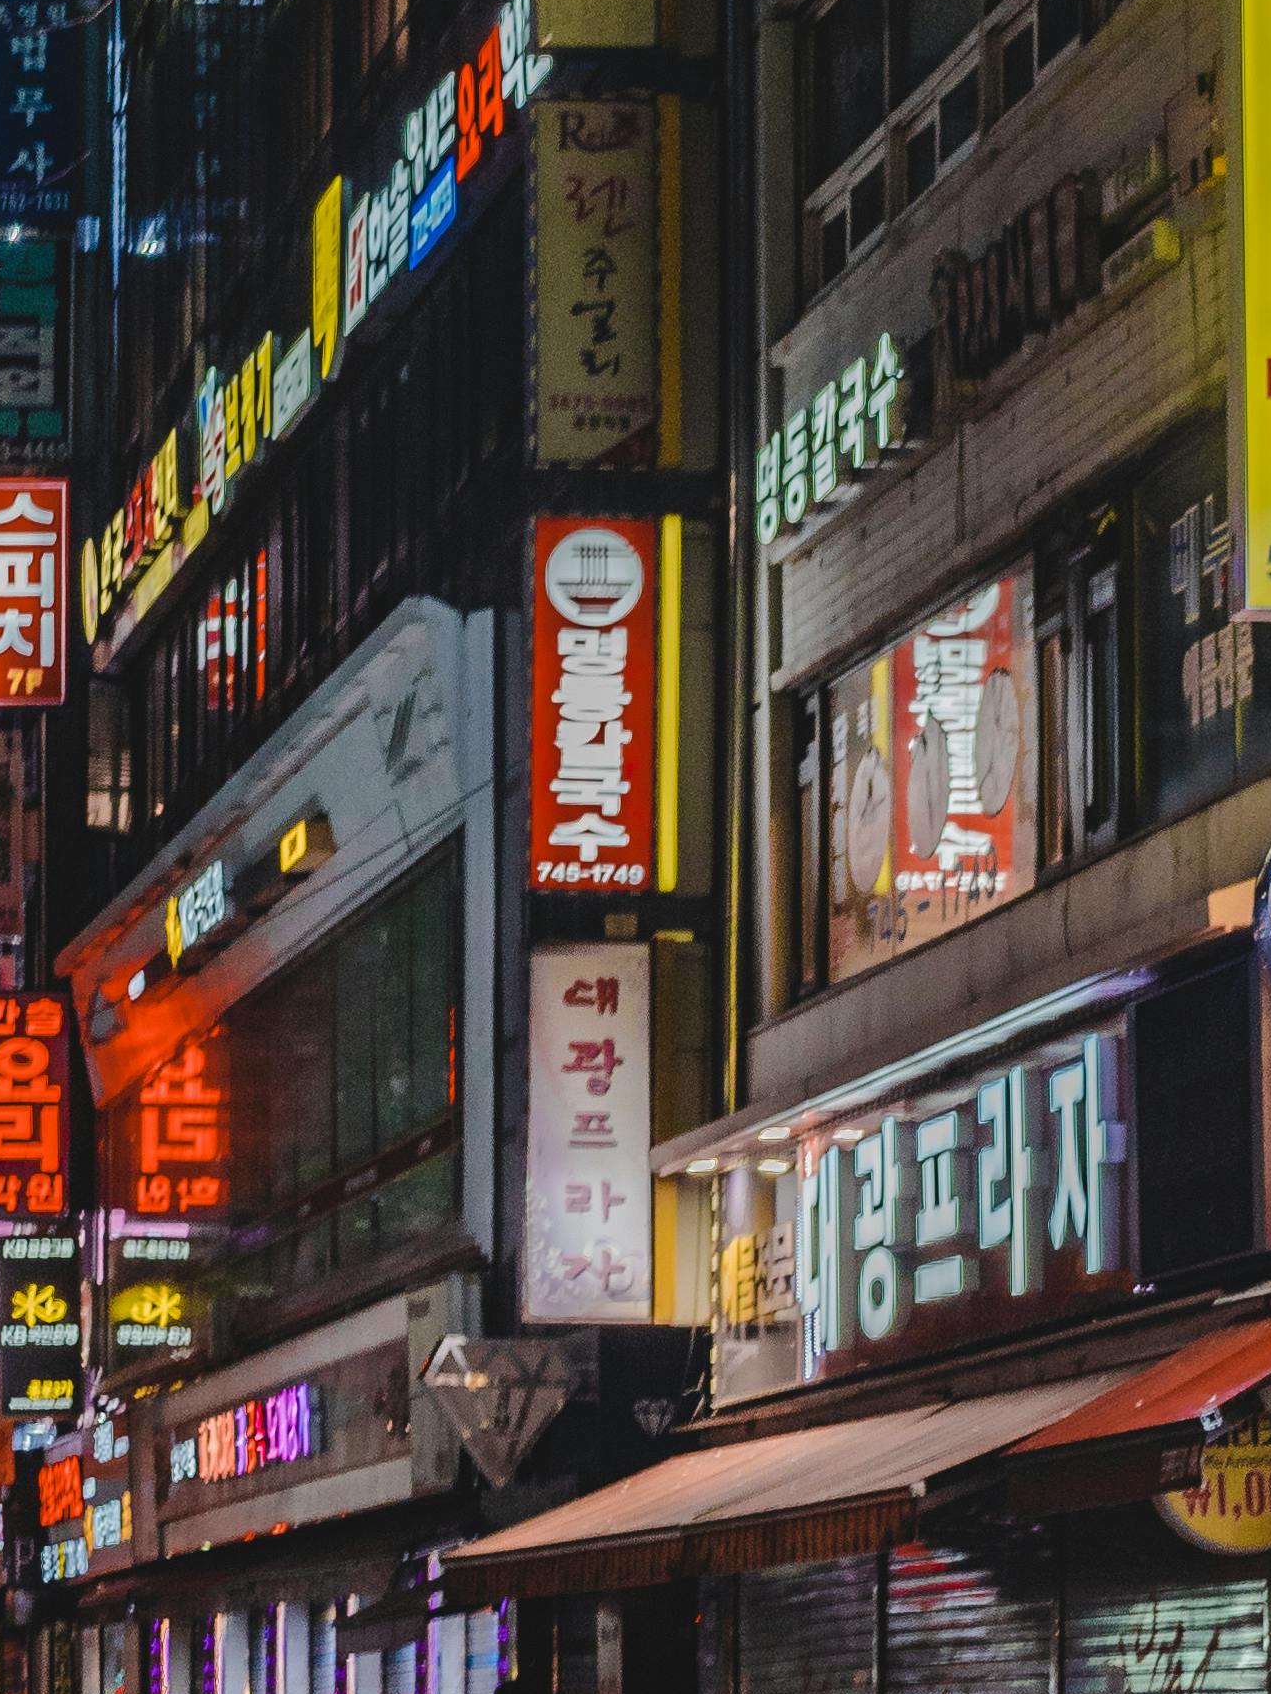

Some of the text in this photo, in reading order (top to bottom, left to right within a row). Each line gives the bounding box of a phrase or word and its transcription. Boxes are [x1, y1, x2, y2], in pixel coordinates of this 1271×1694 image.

[756, 331, 905, 545] 명동칼국수
[6, 668, 43, 696] 7F
[548, 627, 633, 863] 명동칼국수
[536, 861, 645, 885] 745-1749
[562, 975, 626, 1291] 대광프라자
[800, 1032, 1107, 1352] 대광프라자
